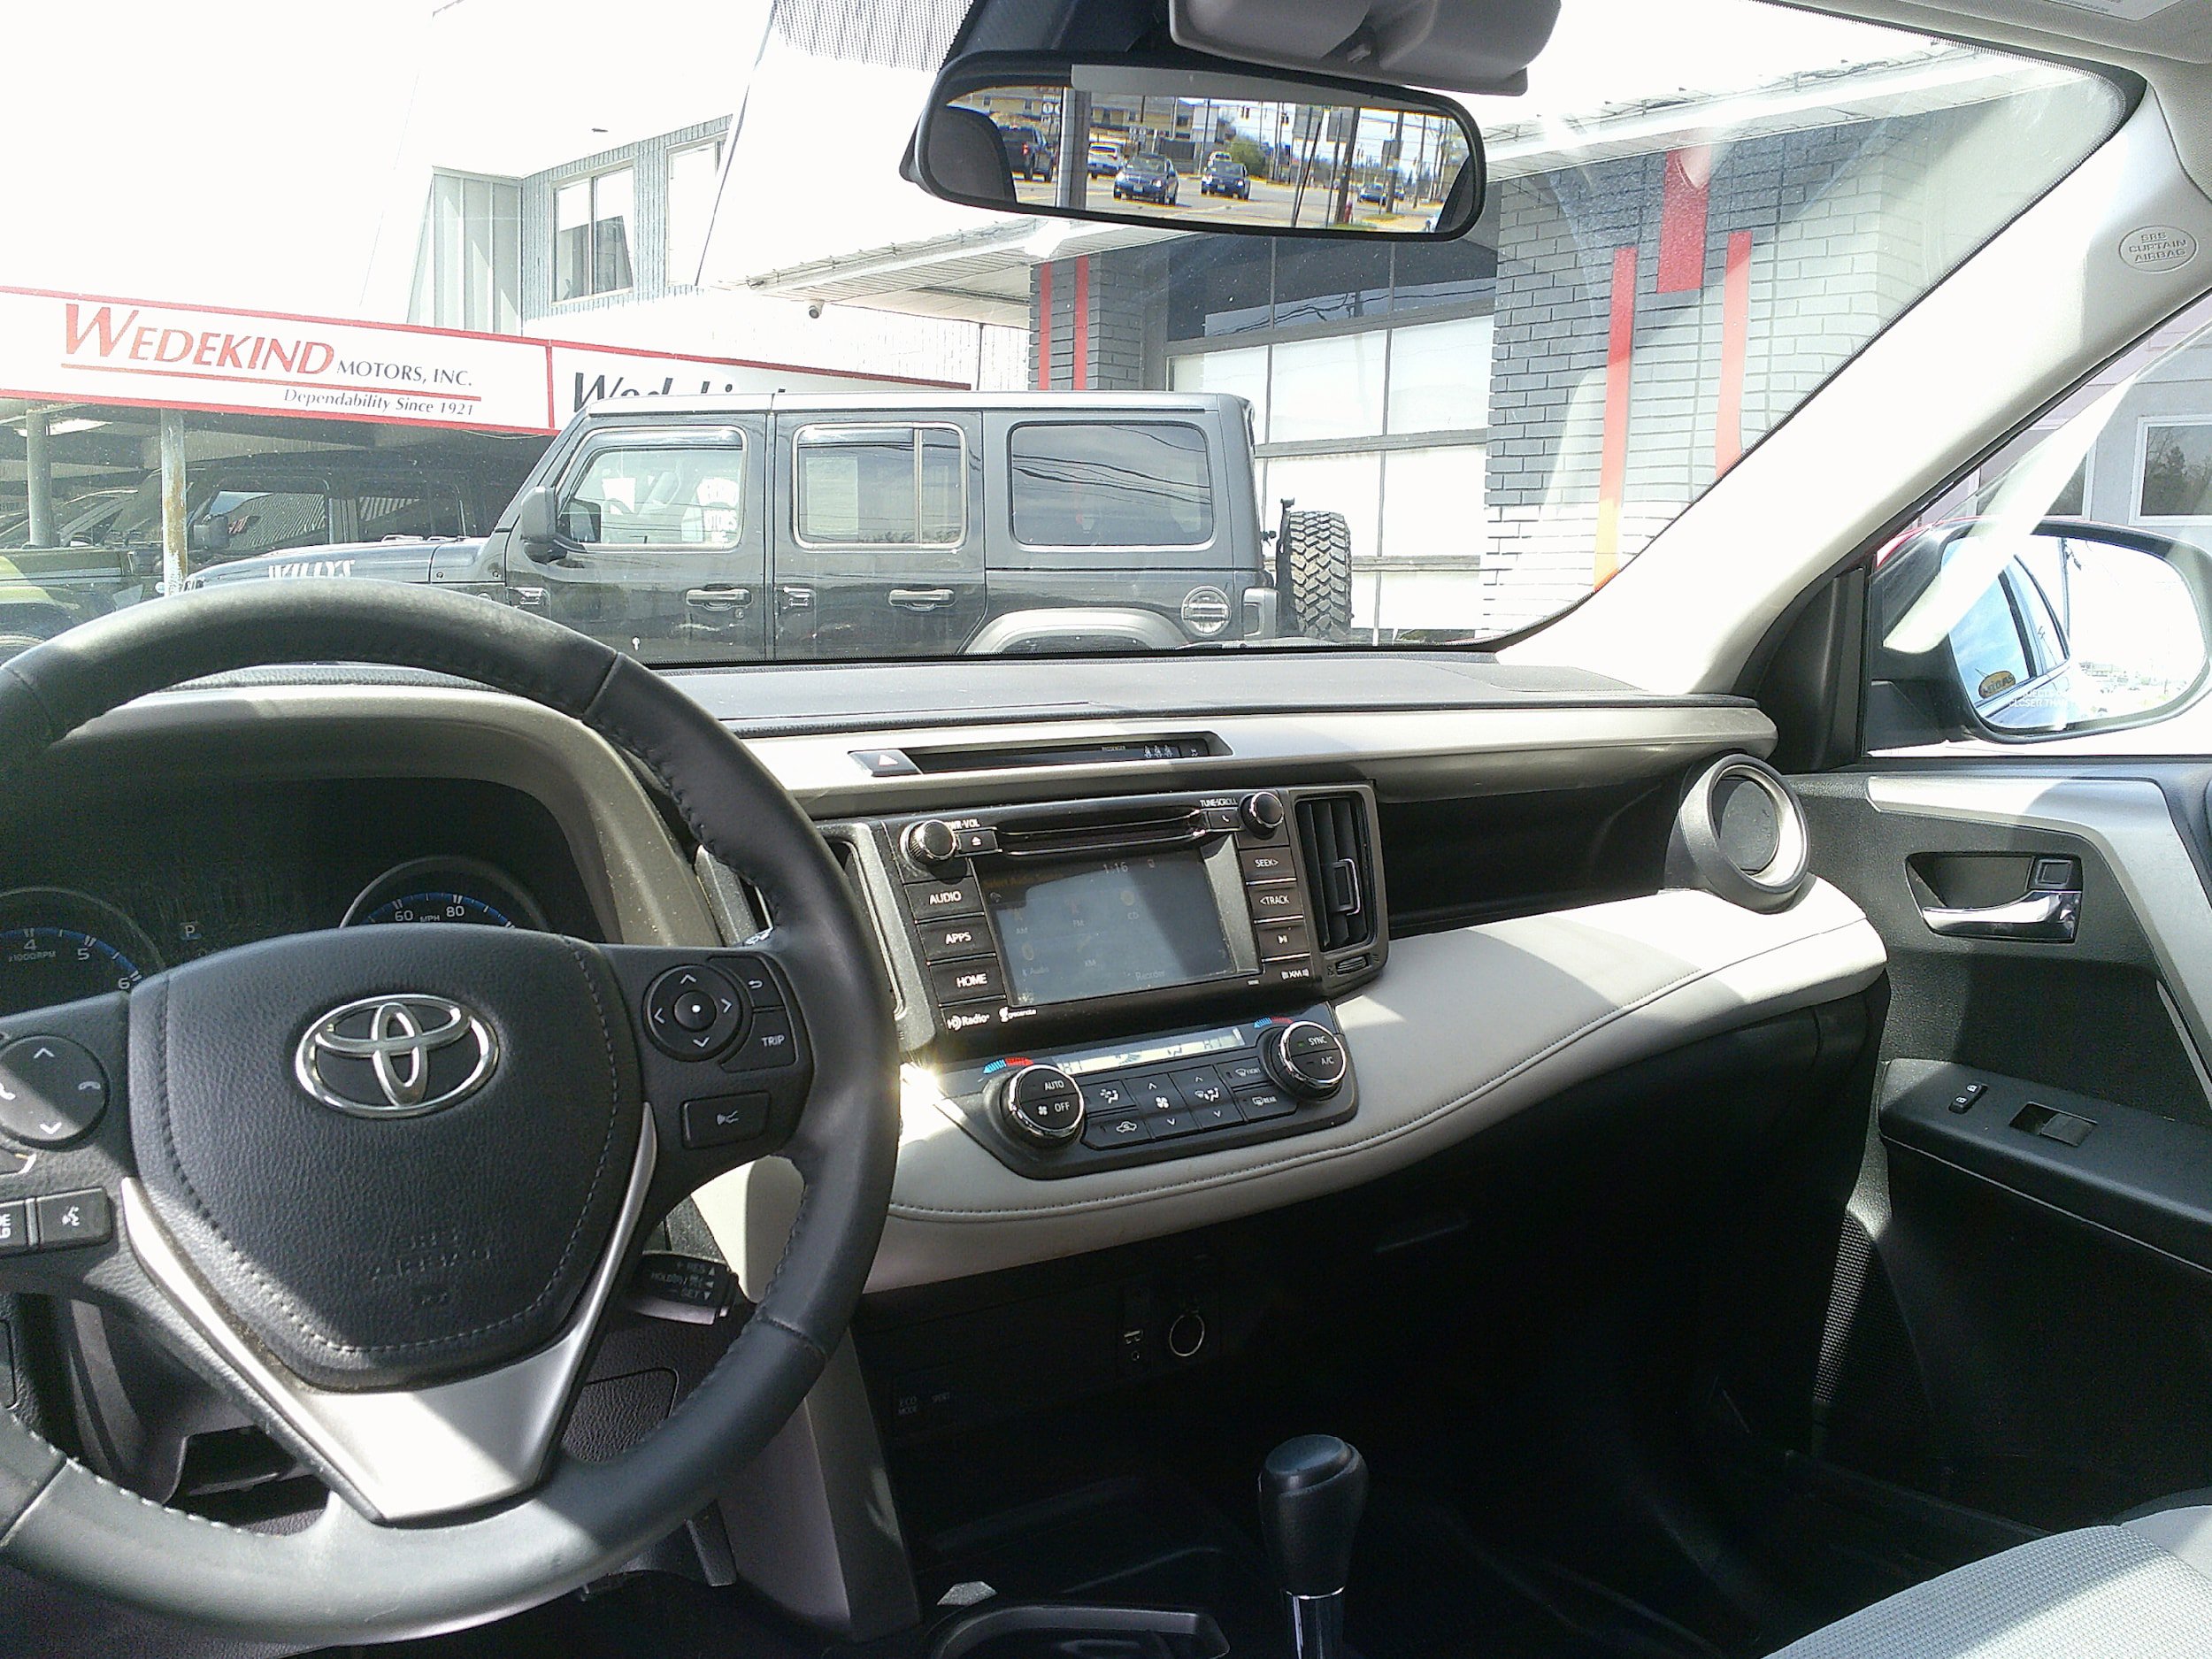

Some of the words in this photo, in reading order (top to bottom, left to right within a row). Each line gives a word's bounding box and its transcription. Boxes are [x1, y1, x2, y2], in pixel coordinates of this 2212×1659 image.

[2129, 239, 2186, 253] CURTAIN
[2134, 249, 2185, 263] AIRBAG
[65, 303, 334, 374] WEDEKIND
[336, 359, 427, 384] MOTORS,
[434, 368, 472, 387] INC.
[284, 388, 390, 412] Dependability
[396, 397, 434, 413] Since
[440, 402, 473, 416] 1921
[929, 890, 962, 905] AUDIO
[395, 910, 414, 922] 60
[446, 905, 465, 918] 80
[184, 925, 196, 938] P
[945, 931, 972, 945] APPS
[23, 939, 37, 951] 4
[77, 948, 89, 961] 5
[118, 977, 130, 989] 6
[956, 972, 988, 988] HOME
[761, 1034, 786, 1047] TRIP
[1308, 1035, 1327, 1046] SYNC
[1321, 1056, 1335, 1066] A/C
[1044, 1079, 1064, 1091] AUTO
[1054, 1101, 1071, 1112] OFF
